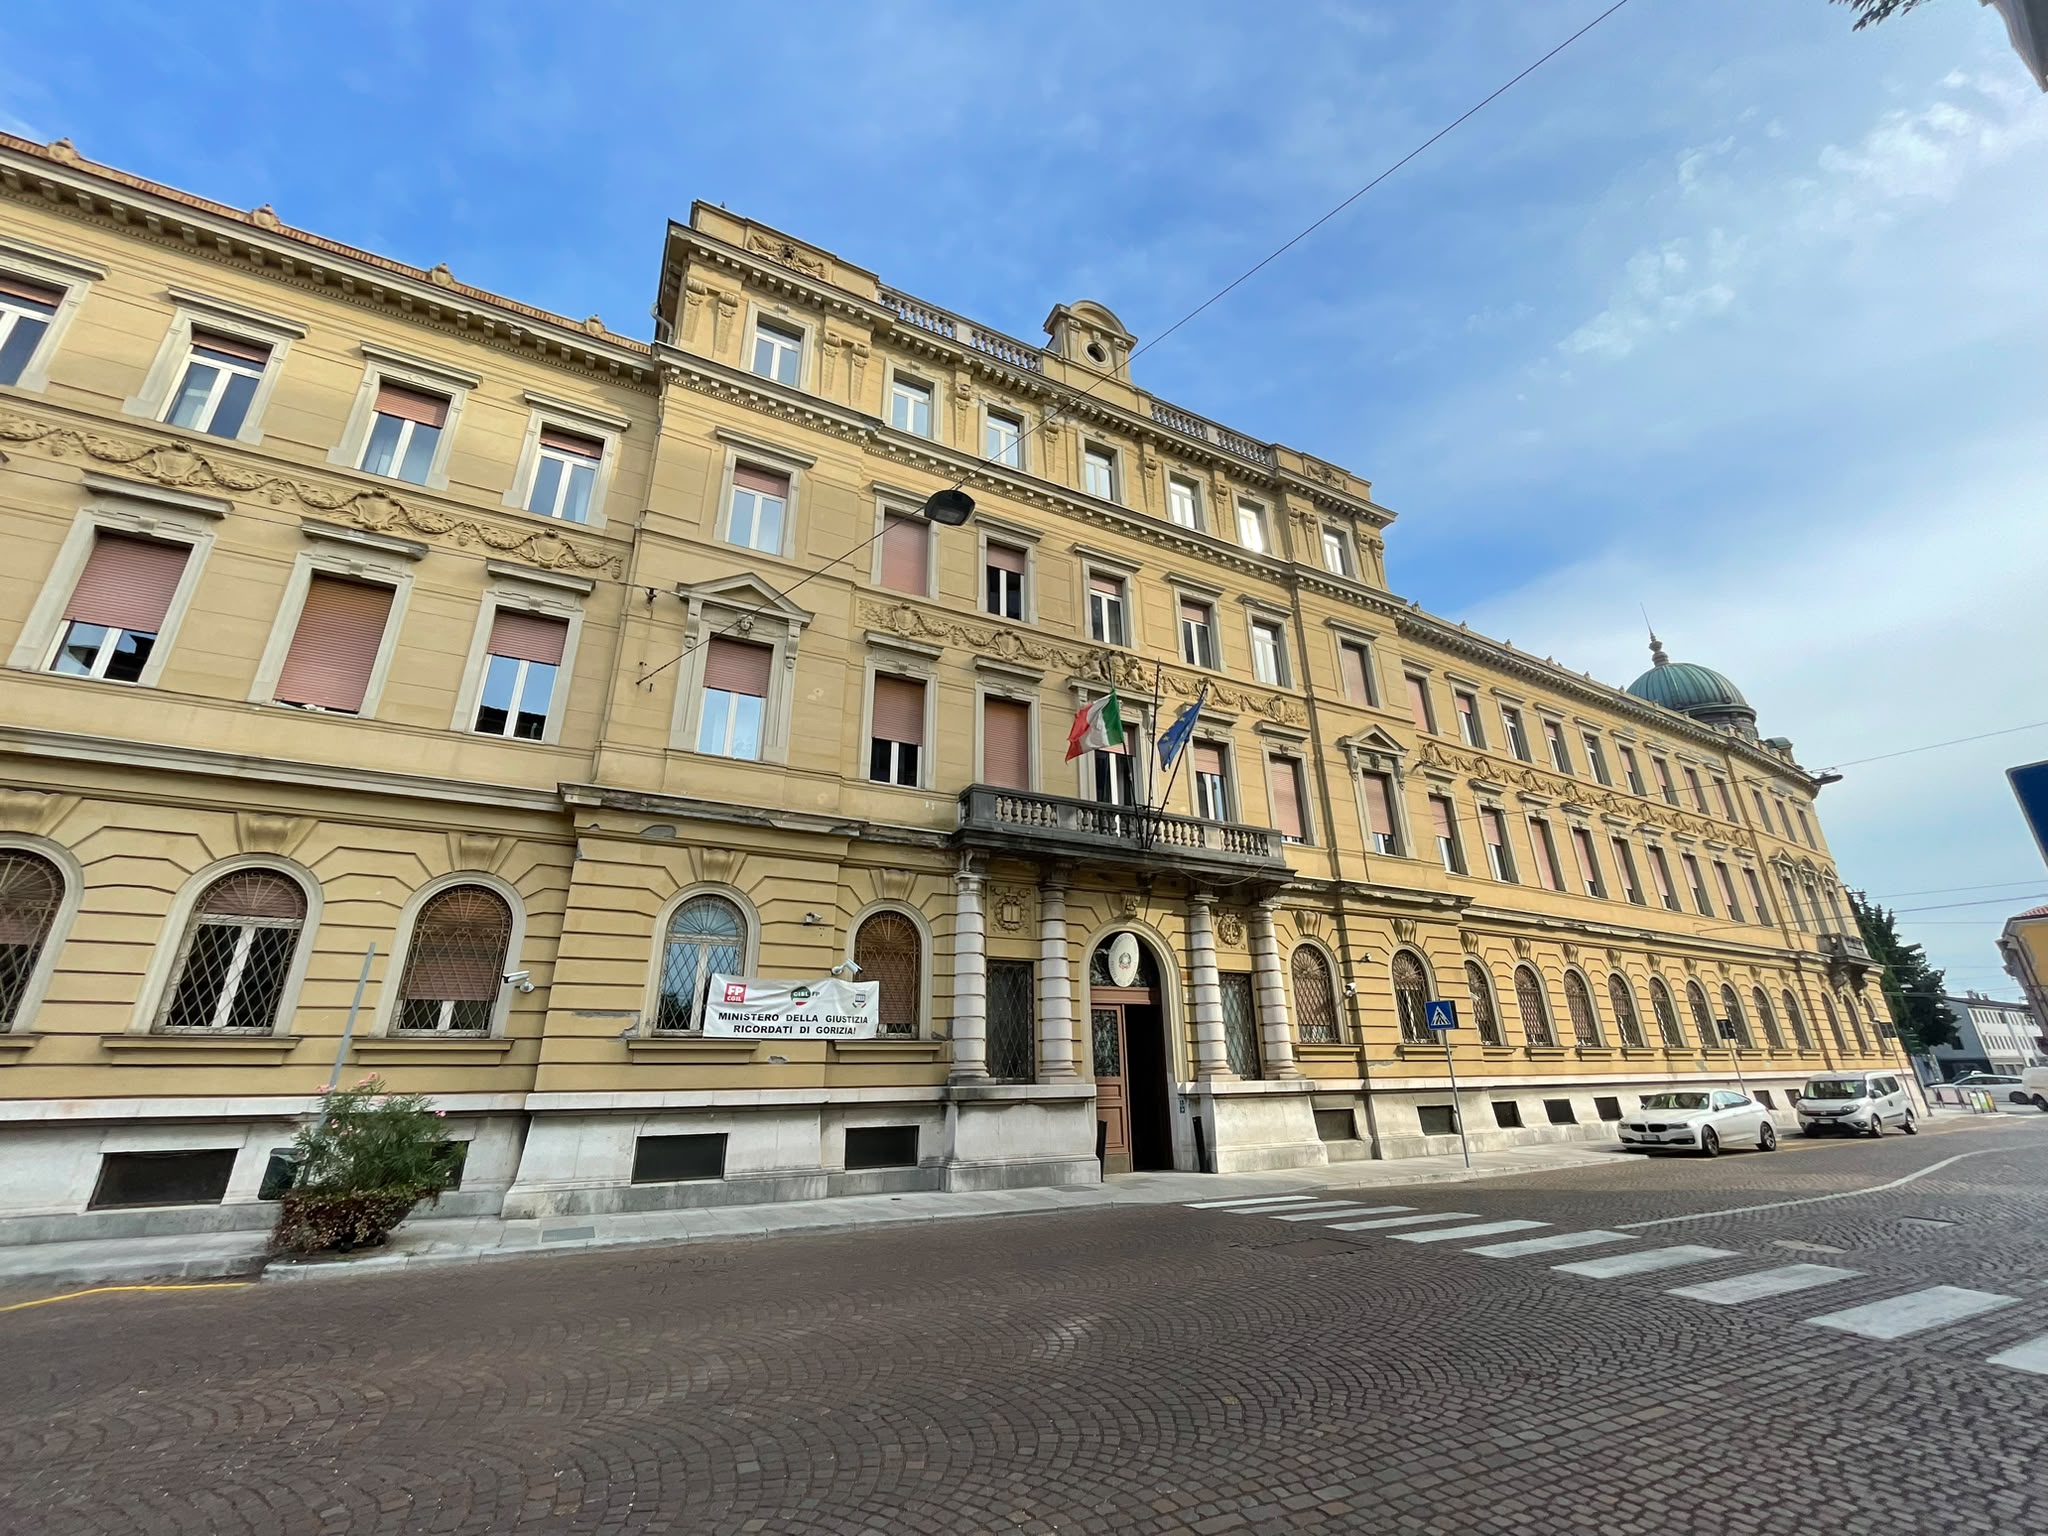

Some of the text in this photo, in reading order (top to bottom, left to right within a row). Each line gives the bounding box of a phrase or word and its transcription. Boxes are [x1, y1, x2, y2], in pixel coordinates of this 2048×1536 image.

[728, 985, 744, 996] FP
[718, 1012, 868, 1024] MINISTERO DELLA GIUSTIZIA
[733, 1025, 856, 1035] RICORDATI DI GORIZIA!
